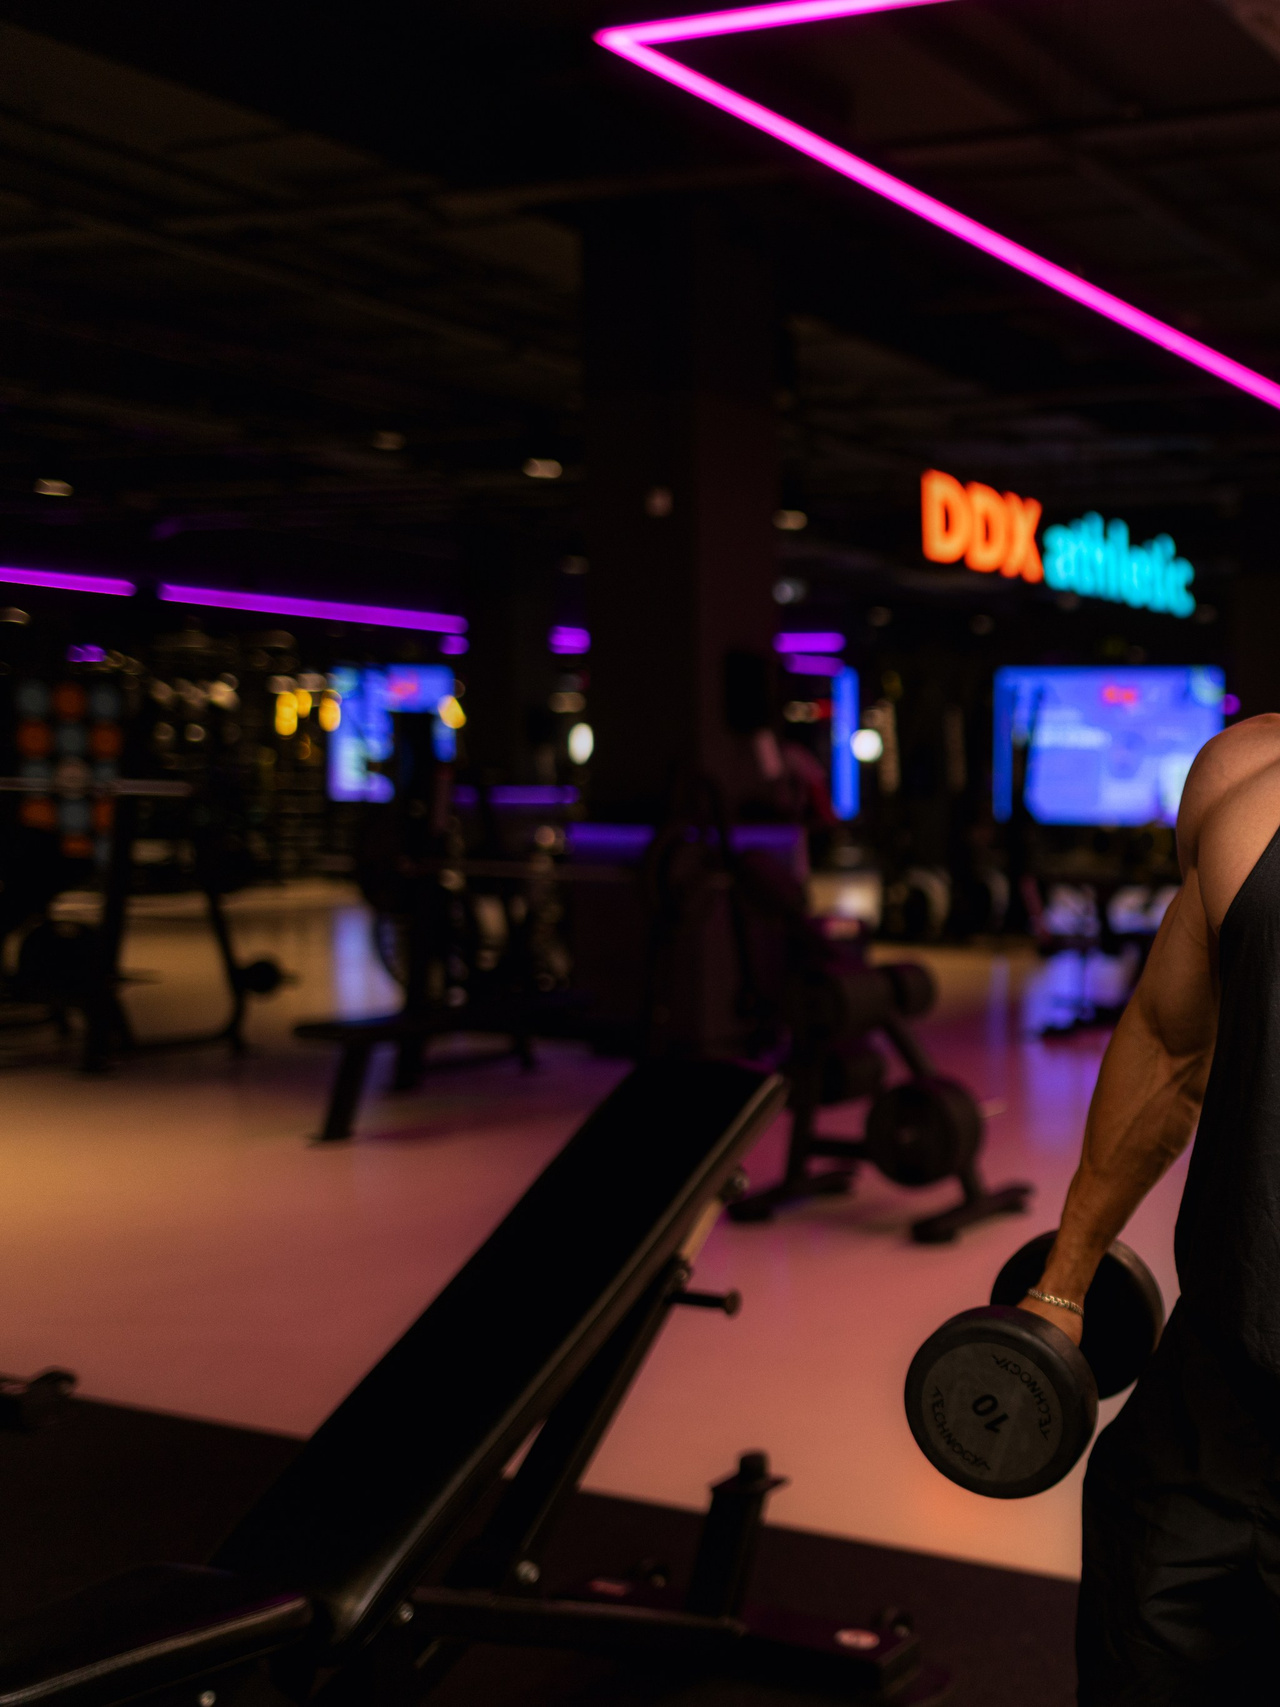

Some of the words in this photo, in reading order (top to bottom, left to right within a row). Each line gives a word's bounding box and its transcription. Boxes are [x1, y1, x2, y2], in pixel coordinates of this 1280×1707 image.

[921, 468, 1044, 584] DDX
[1043, 511, 1195, 618] athletic
[972, 1394, 1009, 1433] 10
